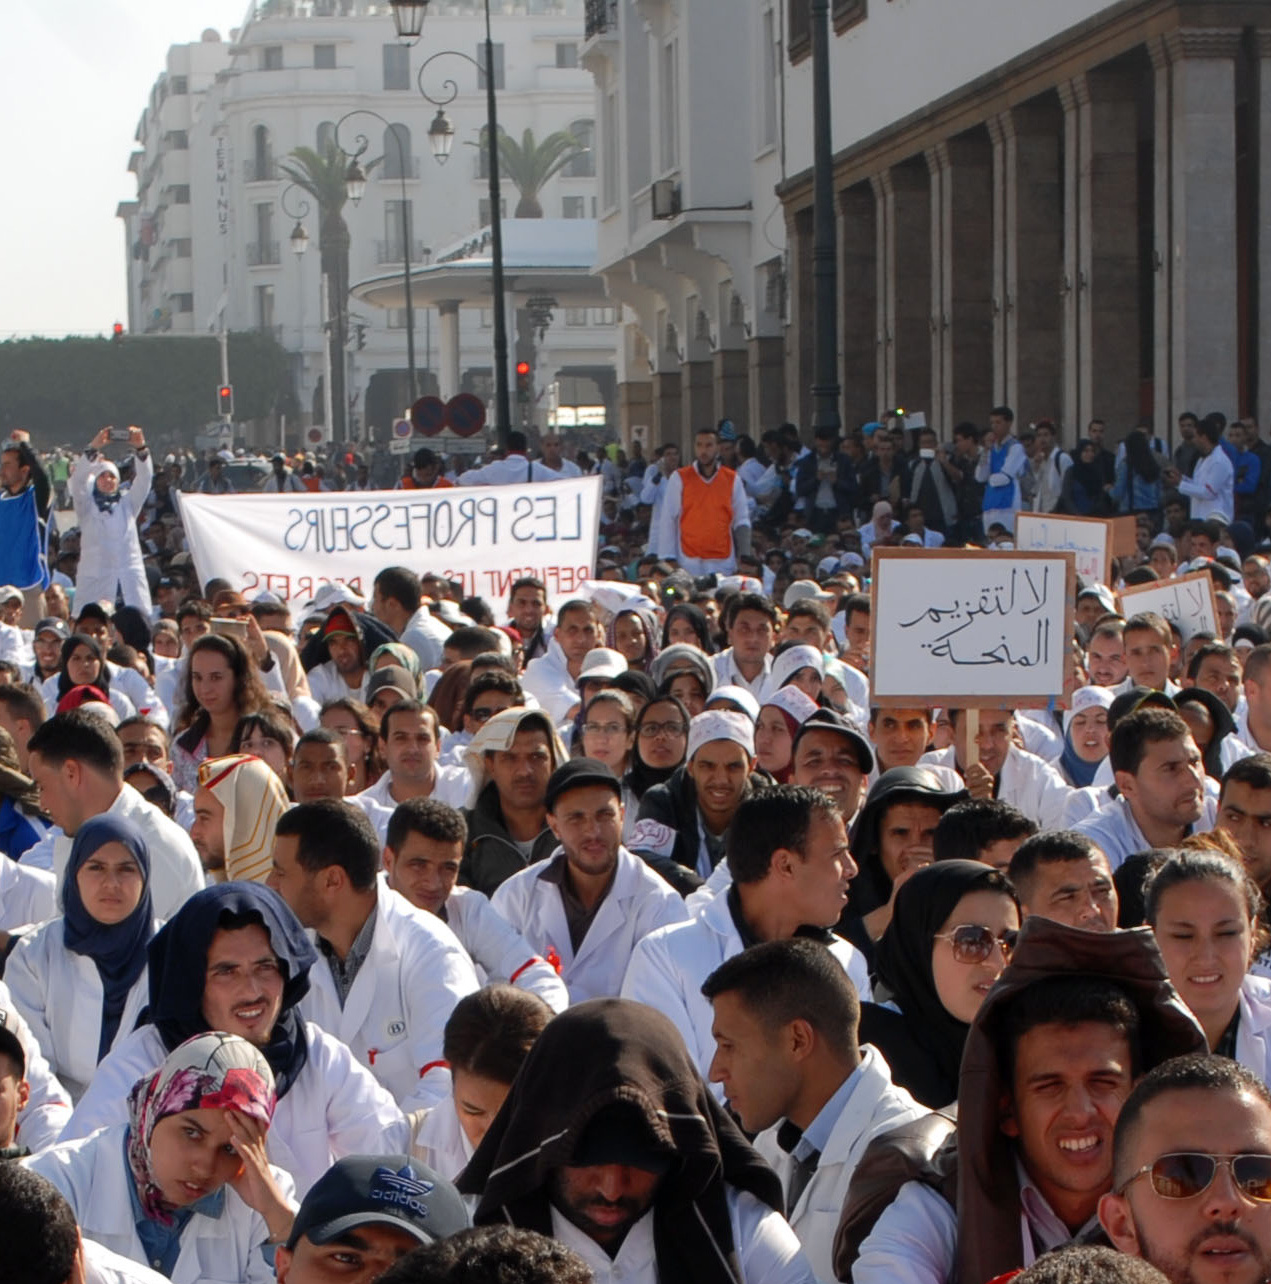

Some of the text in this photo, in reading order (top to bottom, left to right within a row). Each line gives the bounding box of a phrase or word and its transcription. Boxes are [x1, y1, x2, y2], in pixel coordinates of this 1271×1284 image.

[898, 565, 1049, 642] لا لتقزيم
[920, 618, 1049, 667] المنحة
[371, 1187, 429, 1216] adidas
